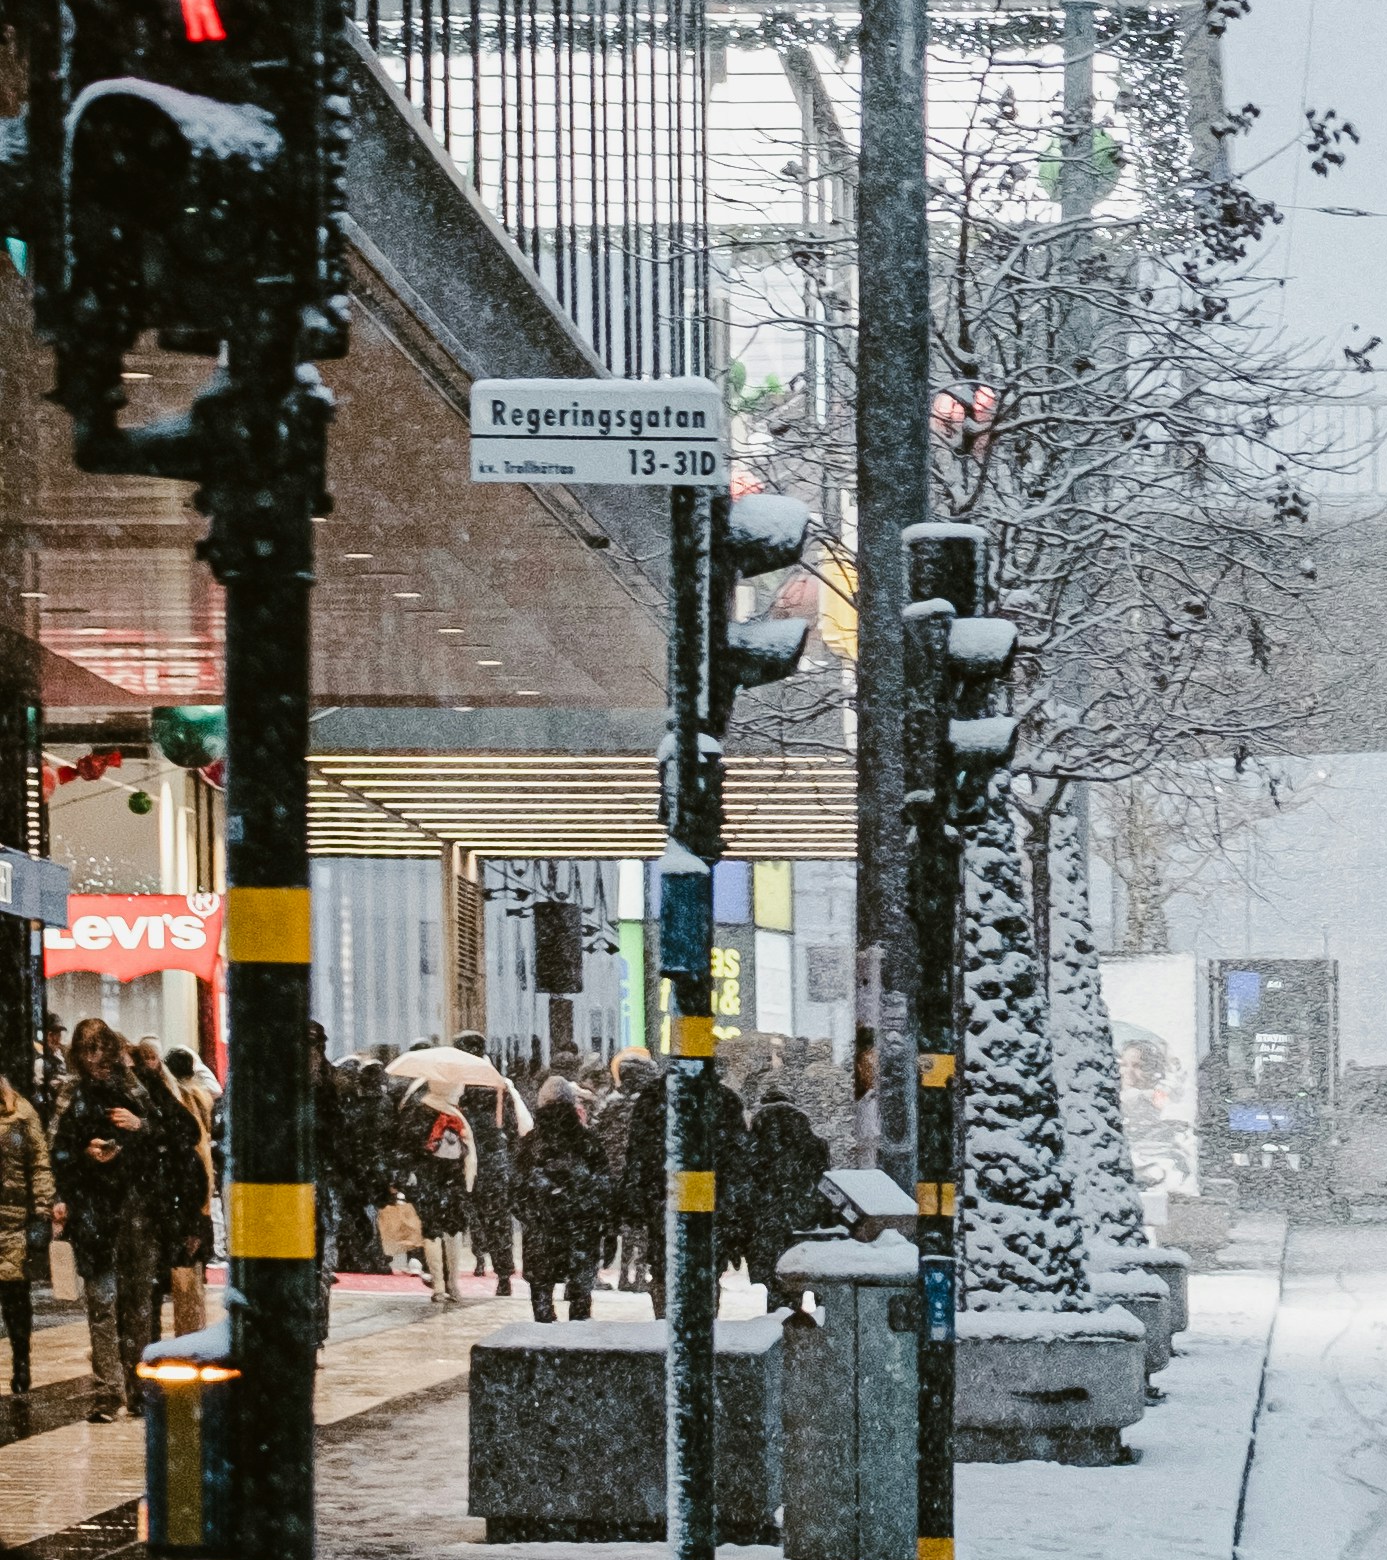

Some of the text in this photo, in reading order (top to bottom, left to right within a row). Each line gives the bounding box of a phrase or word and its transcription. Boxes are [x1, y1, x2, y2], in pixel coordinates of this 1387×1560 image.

[491, 399, 706, 435] Regeringsgatan
[628, 448, 716, 476] 13-31D
[43, 913, 207, 950] Levi's
